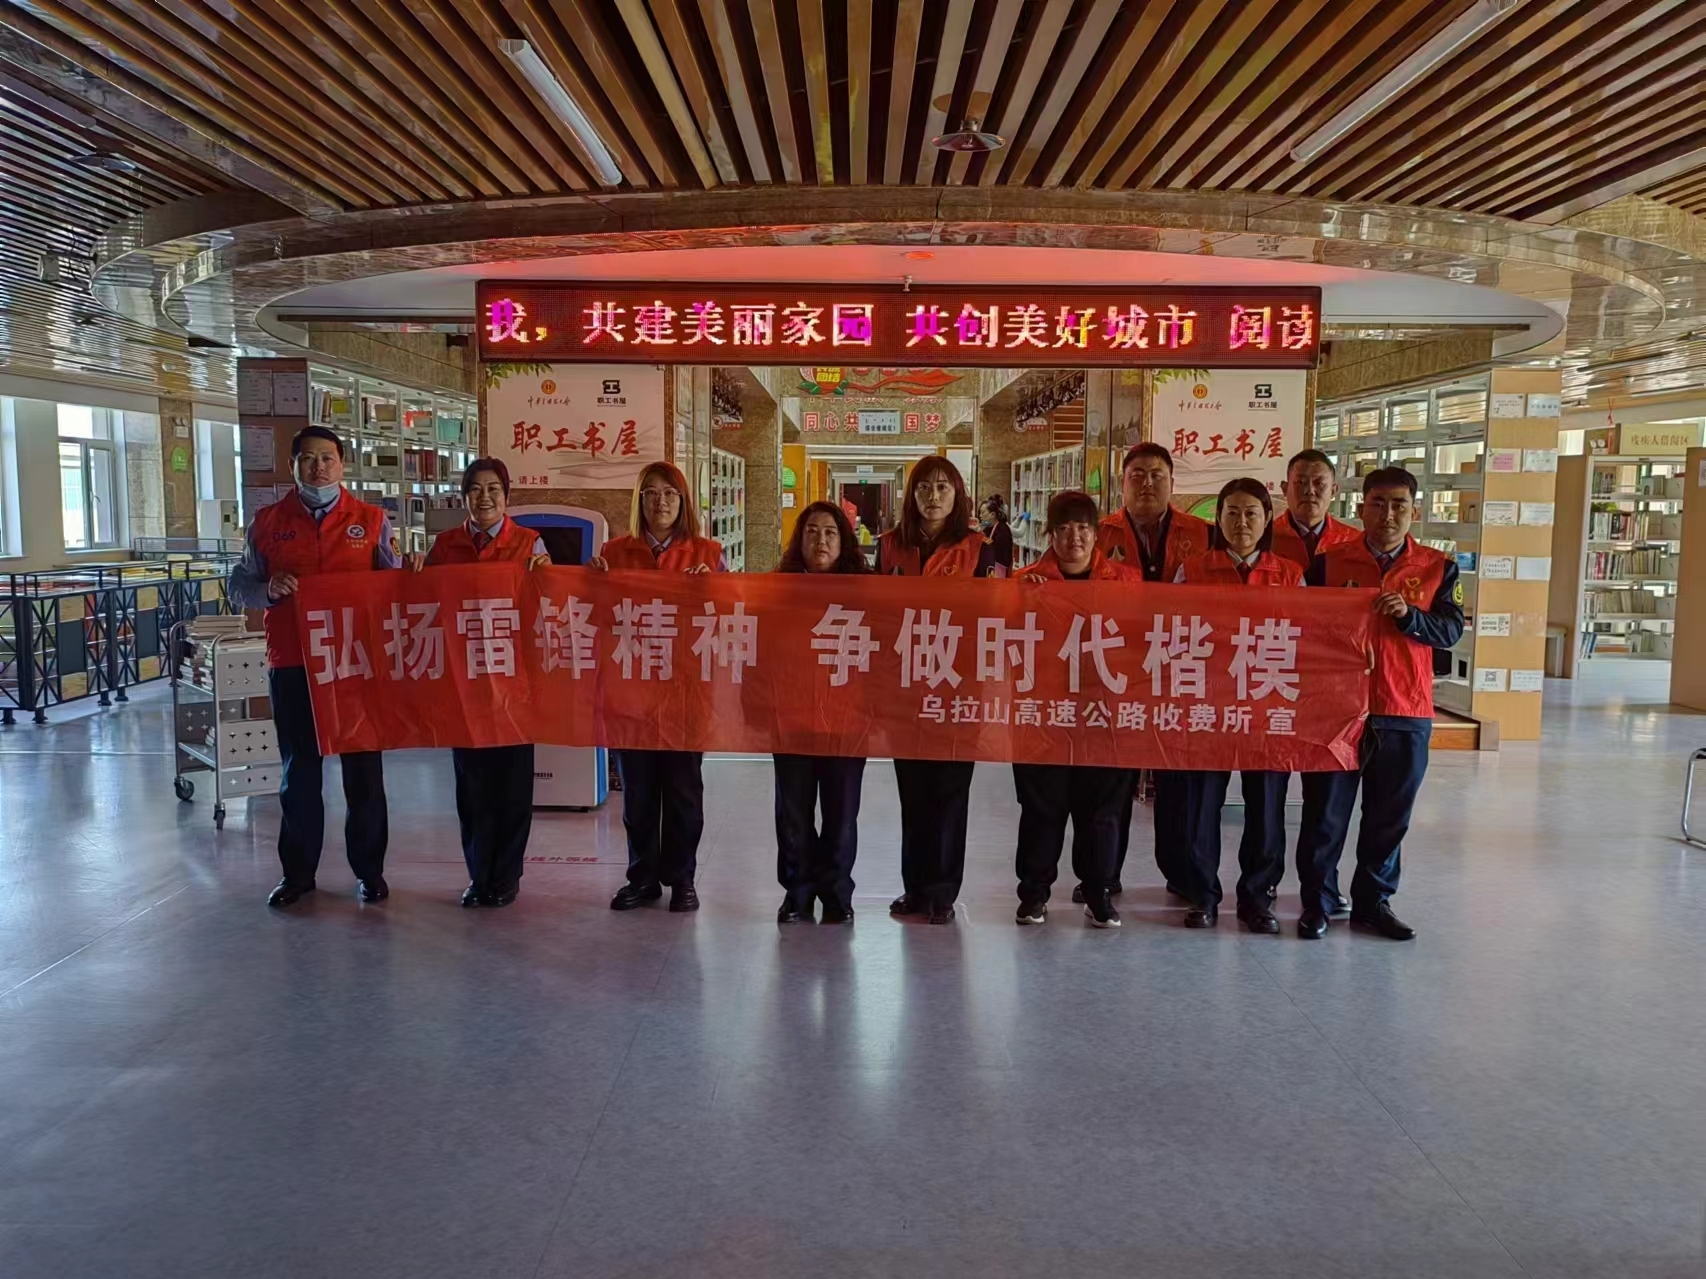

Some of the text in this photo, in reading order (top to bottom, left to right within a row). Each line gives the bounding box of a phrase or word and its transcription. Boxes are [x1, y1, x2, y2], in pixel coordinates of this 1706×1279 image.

[582, 299, 874, 347] 共建美丽家园
[906, 303, 1198, 350] 共创美好城市
[597, 397, 627, 405] 职工书屋
[1248, 401, 1278, 409] 职工书屋
[511, 419, 640, 458] 职工书屋
[1171, 427, 1284, 461] 职工书屋
[518, 476, 549, 486] 请上楼
[306, 595, 1303, 702] 弘扬雷锋精神 争做时代楷模
[918, 694, 1297, 736] 乌拉山高速公路收费所 宣
